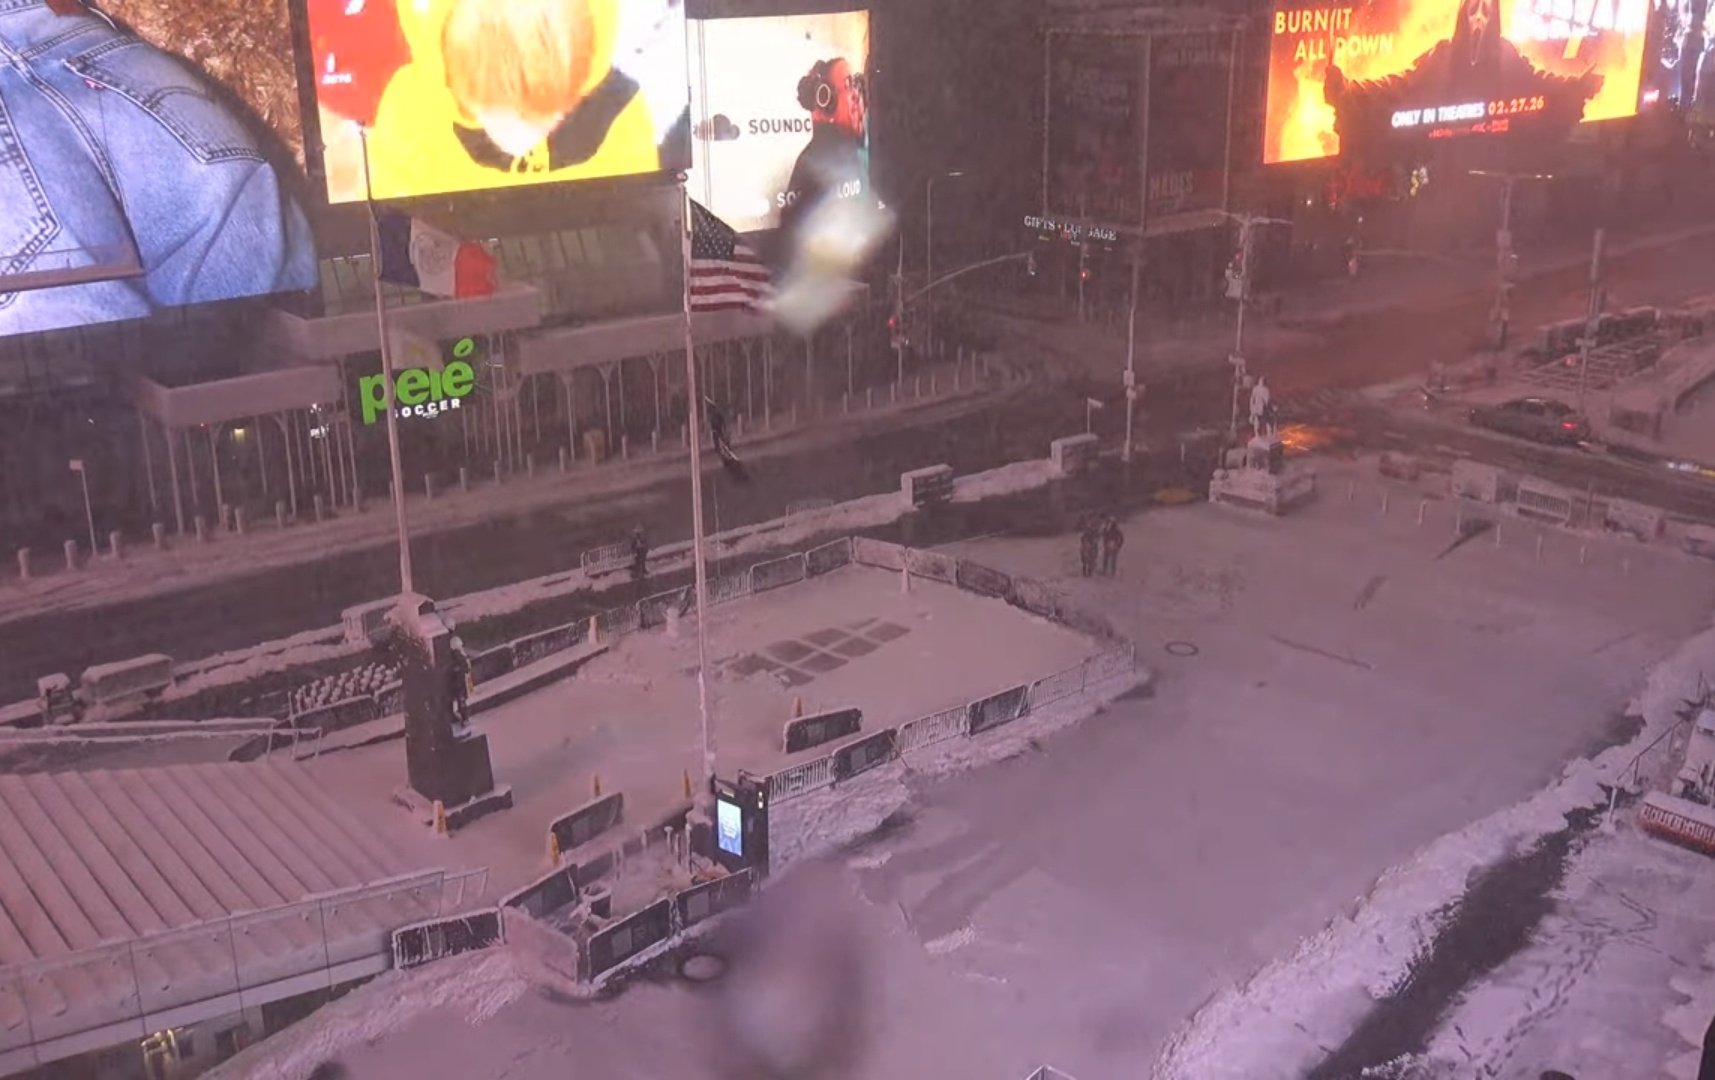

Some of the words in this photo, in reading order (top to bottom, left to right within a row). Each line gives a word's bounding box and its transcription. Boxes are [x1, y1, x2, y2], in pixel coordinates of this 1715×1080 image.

[1275, 10, 1328, 34] BURN
[1335, 8, 1352, 30] IT
[1294, 38, 1326, 60] ALL
[1333, 33, 1393, 59] DOWN
[1391, 108, 1421, 128] ONLY
[1422, 107, 1436, 124] IN
[1488, 96, 1545, 115] 02.27.26
[748, 118, 812, 135] SOUNDC
[1023, 215, 1056, 230] GIFTS
[1064, 222, 1117, 240] LUAGE
